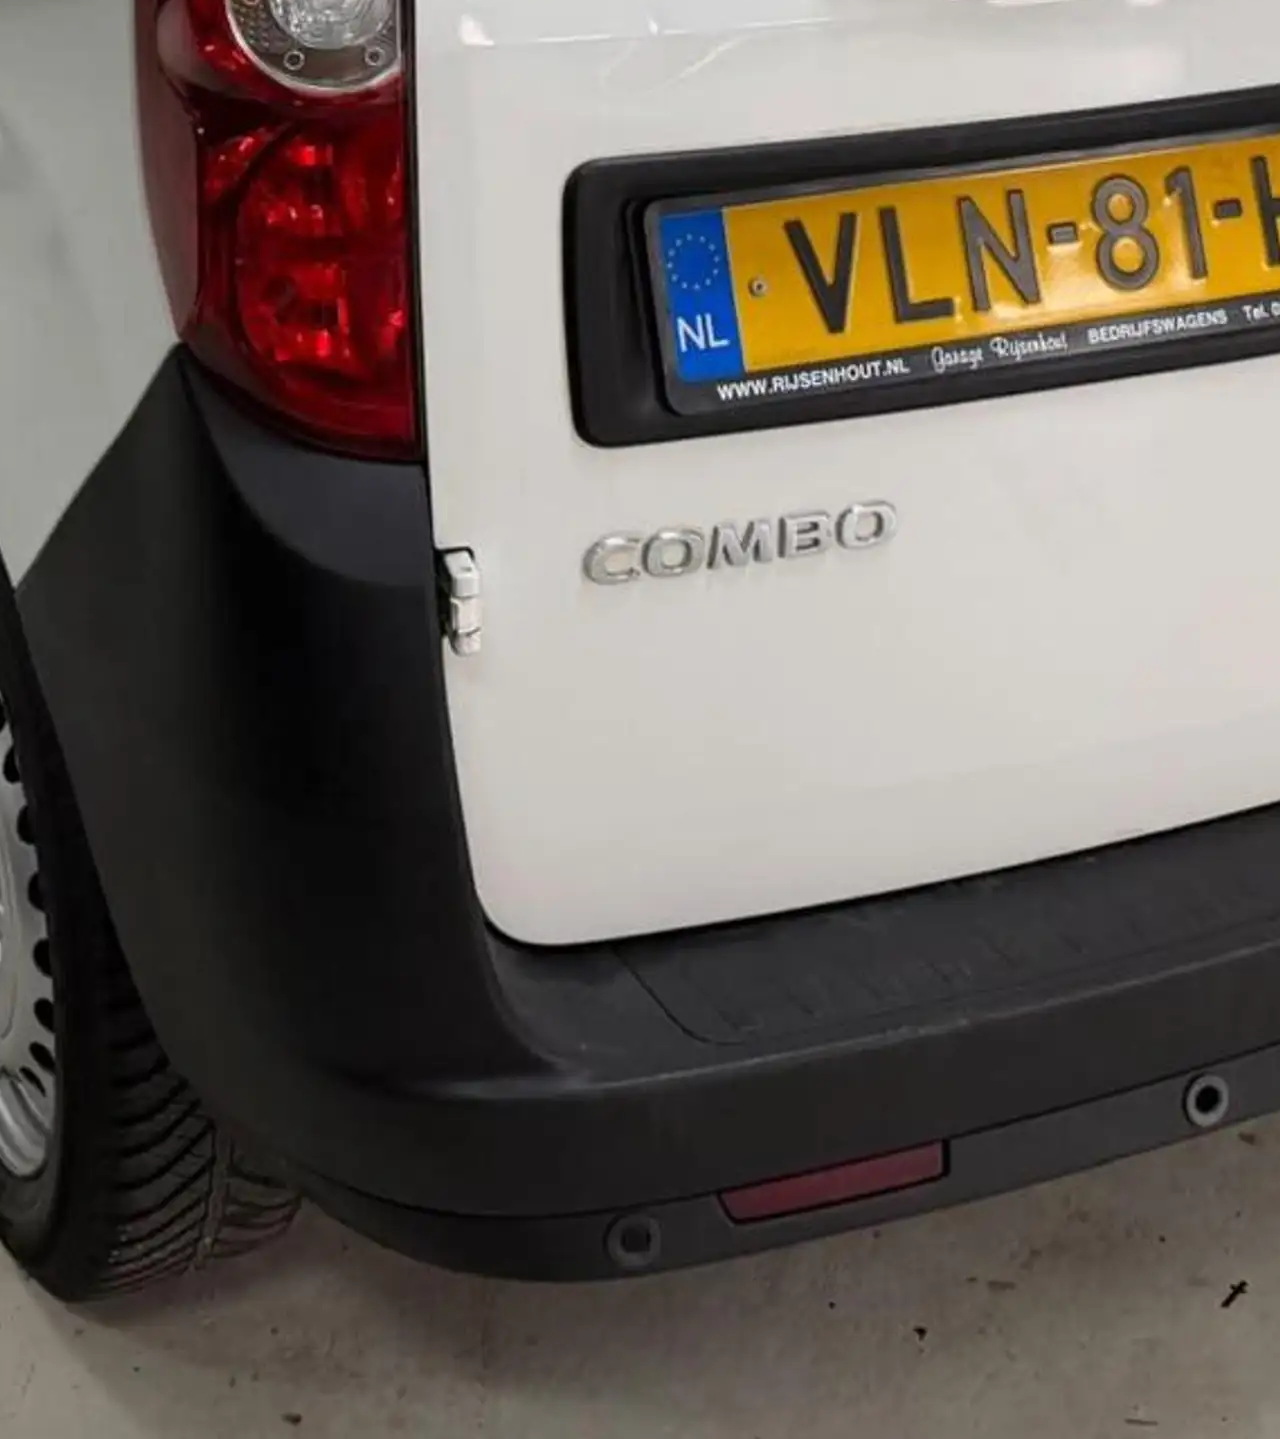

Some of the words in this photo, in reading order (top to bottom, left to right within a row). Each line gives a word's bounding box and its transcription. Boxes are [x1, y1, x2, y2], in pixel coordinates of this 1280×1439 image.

[677, 314, 730, 352] NL
[717, 359, 911, 401] WWW.RIJSENHOUT.NL
[1087, 308, 1228, 344] BEDRIJFSWAGENS
[582, 500, 898, 585] COMBO
